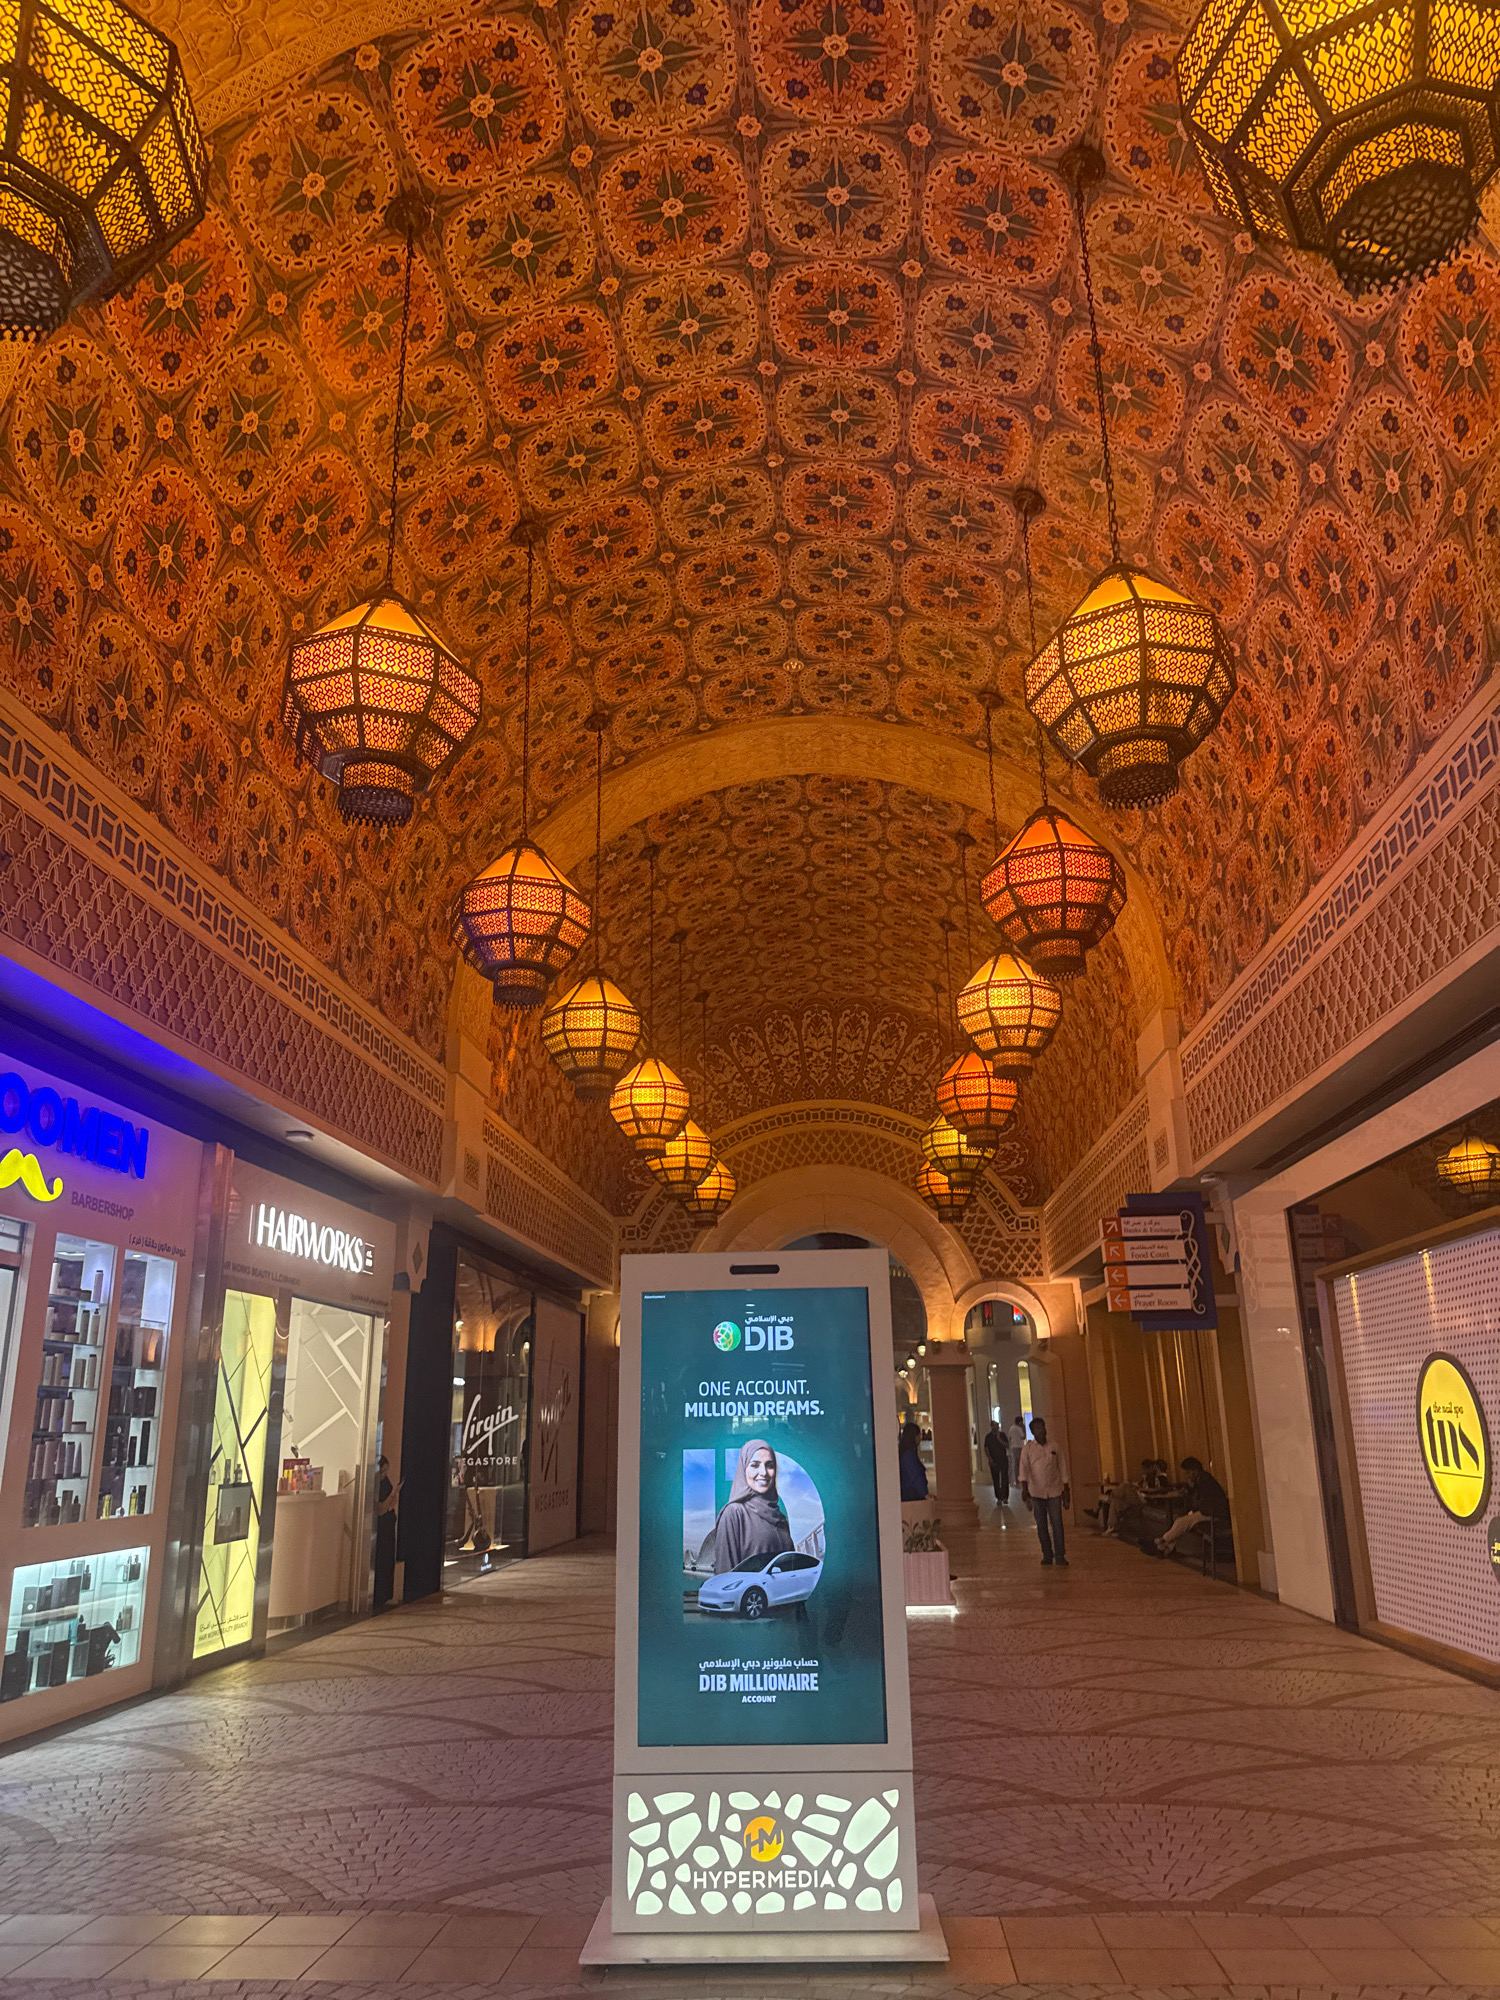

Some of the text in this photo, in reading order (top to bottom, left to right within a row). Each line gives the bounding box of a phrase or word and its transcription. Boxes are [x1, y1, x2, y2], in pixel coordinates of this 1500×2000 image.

[71, 1191, 134, 1221] BARBERSHOP
[257, 1203, 364, 1273] HAIRWORKS
[1131, 1250, 1170, 1259] Food Court
[1134, 1299, 1178, 1309] Prayer Room
[777, 1316, 794, 1325] دبي
[744, 1325, 795, 1352] DIB
[698, 1379, 810, 1396] ONE ACCOUNT.
[684, 1400, 825, 1418] MILLION DREAMS.
[461, 1393, 520, 1456] Virgin
[699, 1658, 819, 1672] حساب مليونير دبي الإسلامي
[699, 1673, 819, 1692] DIB MILLIONAIRE
[741, 1695, 777, 1703] ACCOUNT
[693, 1869, 836, 1889] HYPERMEDIA
